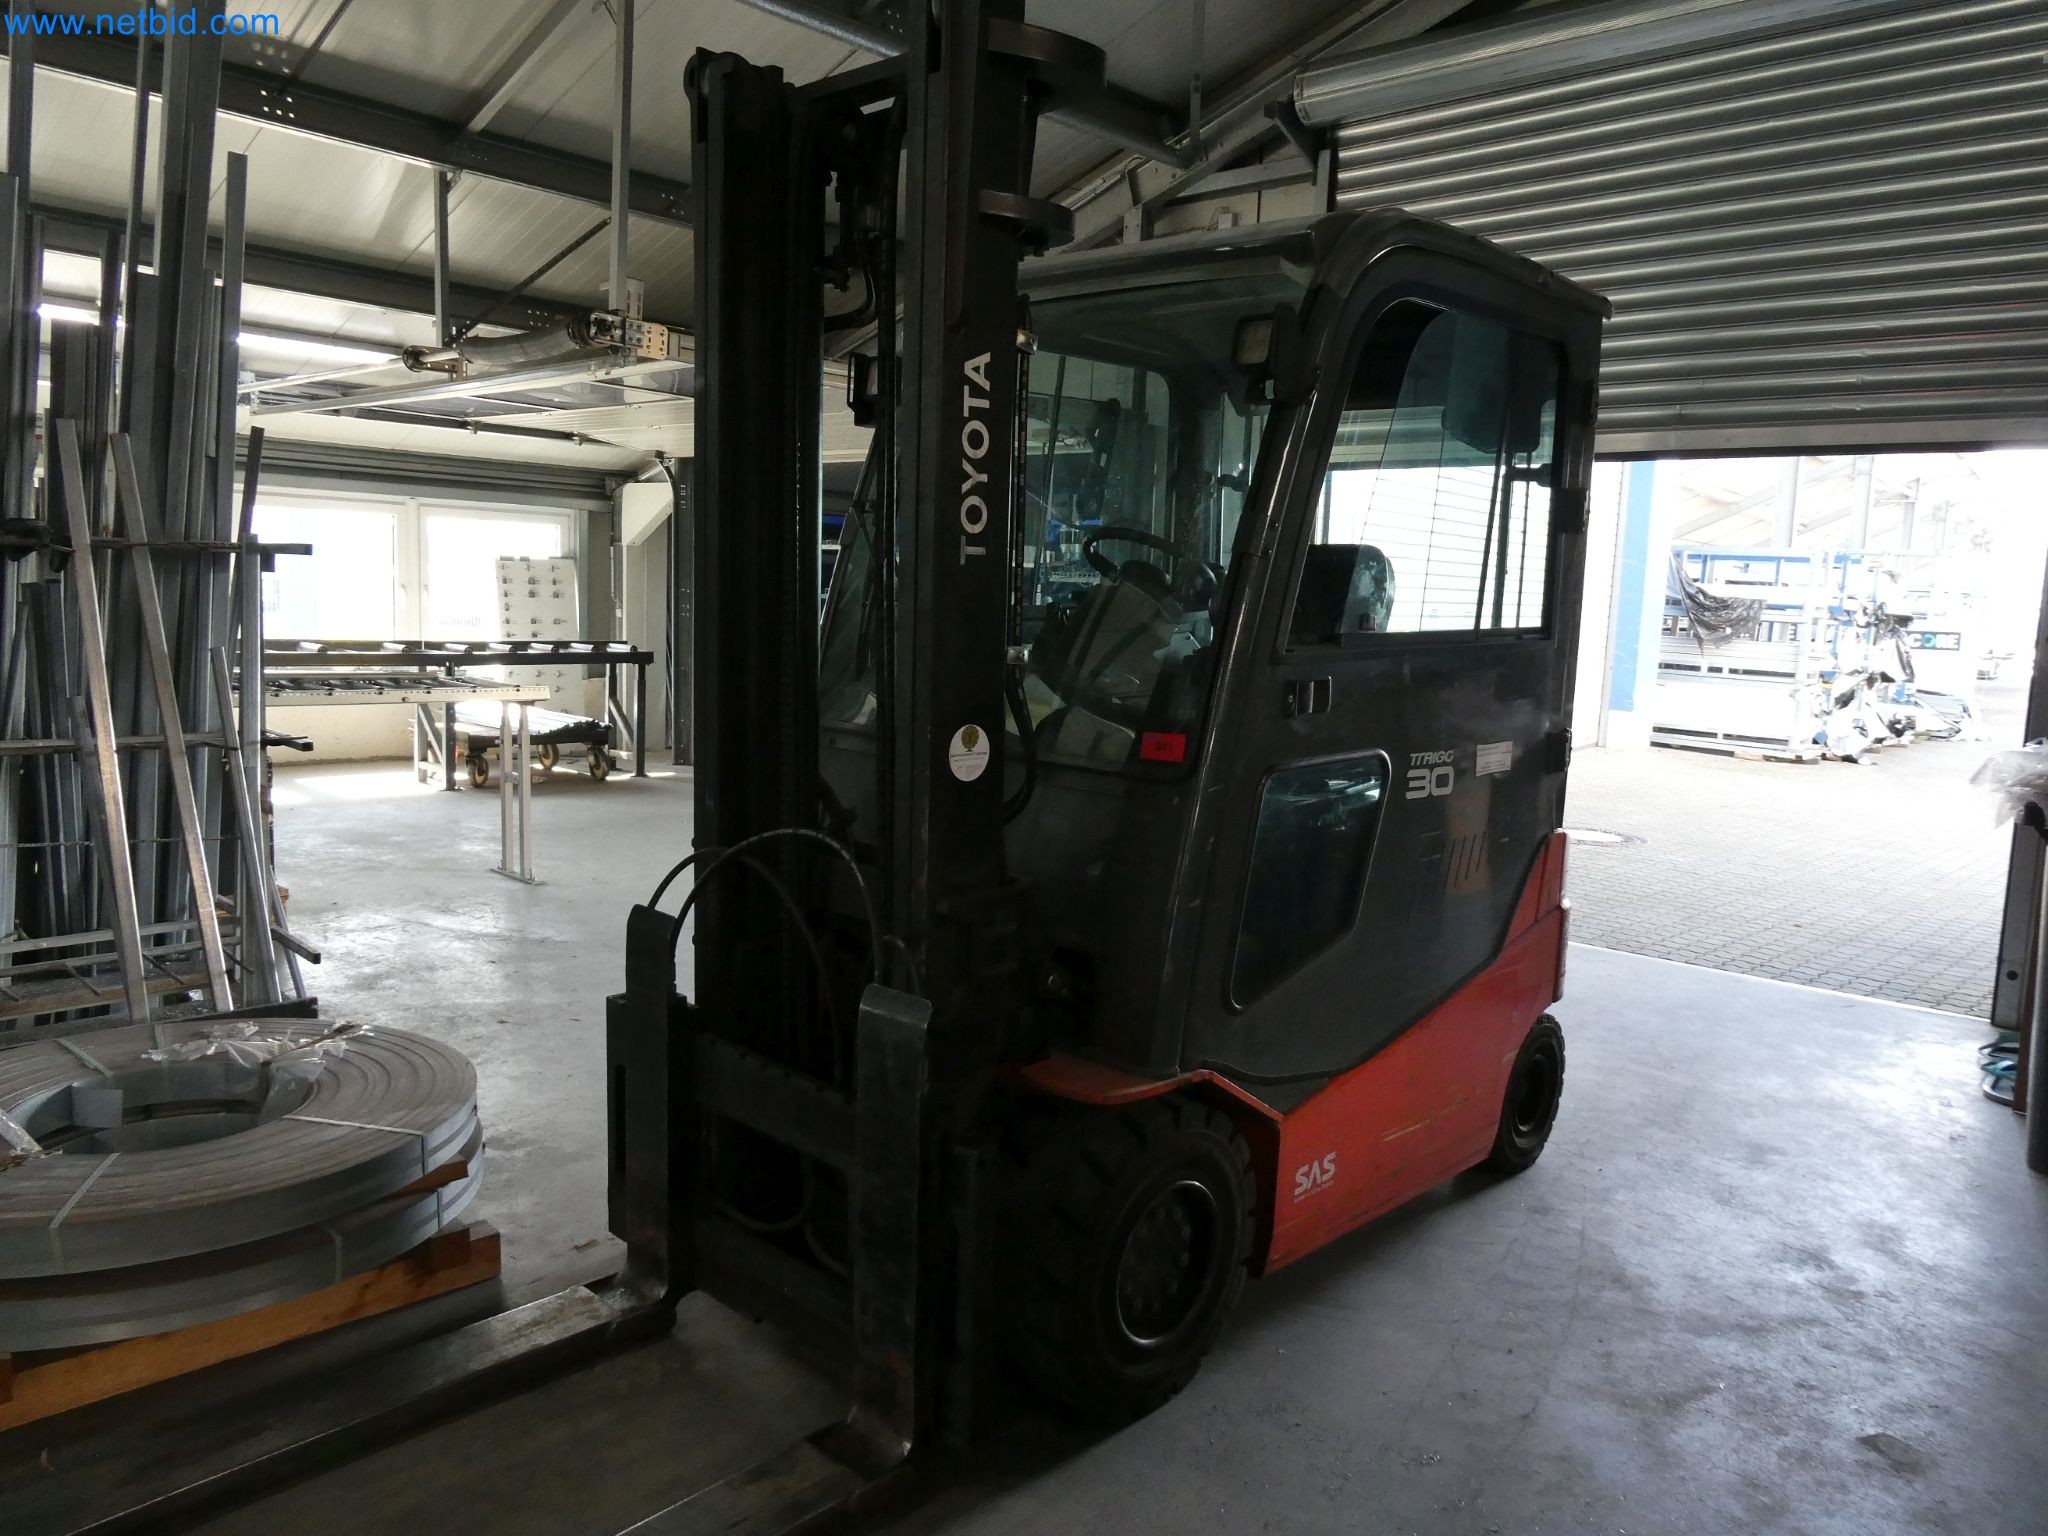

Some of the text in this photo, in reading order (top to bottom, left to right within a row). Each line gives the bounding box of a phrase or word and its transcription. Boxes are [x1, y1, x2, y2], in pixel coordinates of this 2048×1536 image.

[960, 352, 991, 565] TOYOTA
[1406, 765, 1454, 800] 30
[1295, 1152, 1336, 1196] SAS
